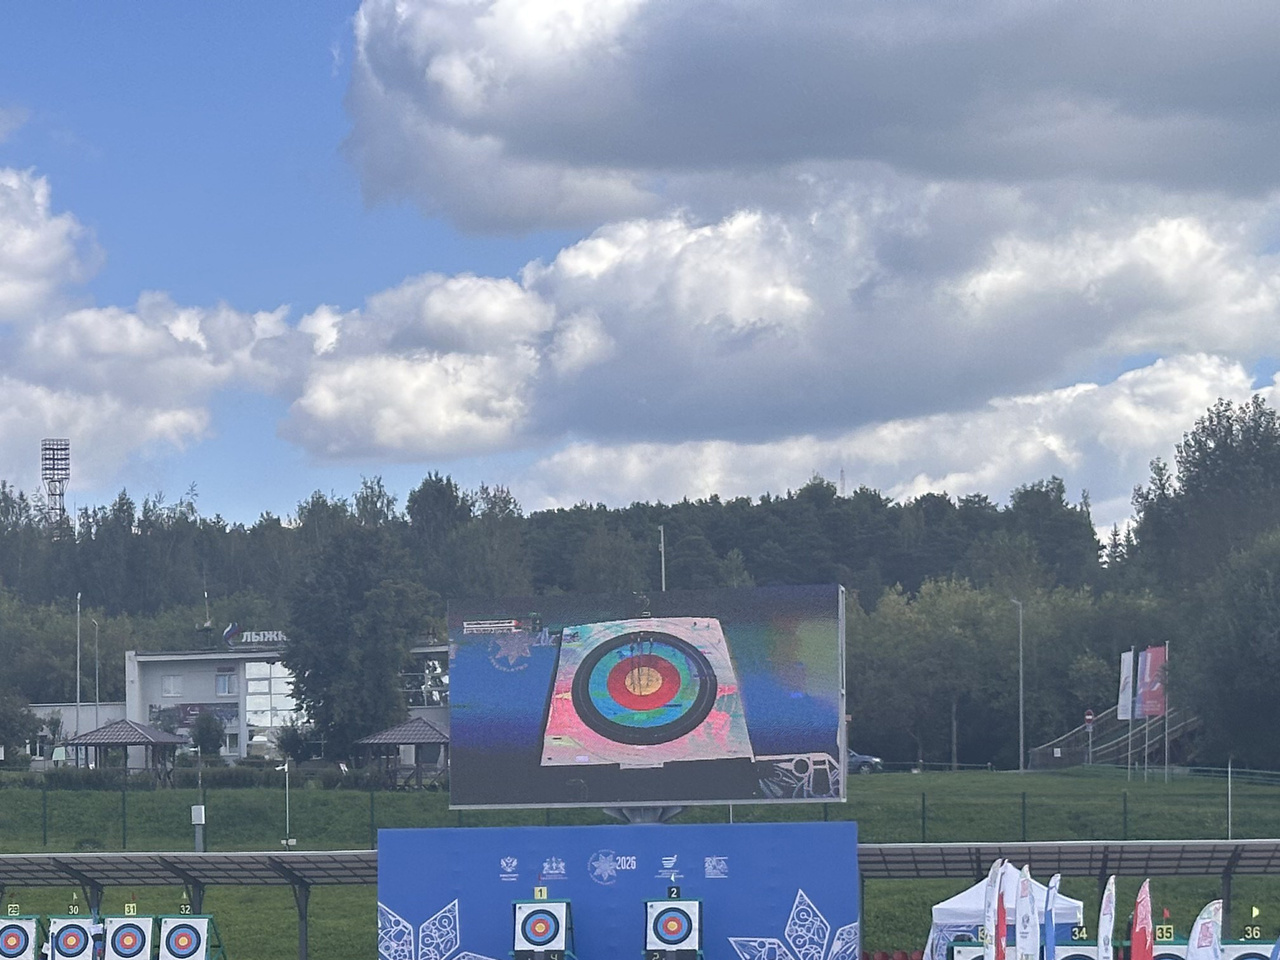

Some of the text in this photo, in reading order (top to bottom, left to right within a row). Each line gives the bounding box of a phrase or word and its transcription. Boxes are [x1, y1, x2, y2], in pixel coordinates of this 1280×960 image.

[615, 856, 637, 870] 2026
[670, 887, 677, 898] 2
[1072, 927, 1088, 940] 34
[1156, 926, 1172, 940] 35
[1244, 926, 1261, 939] 36
